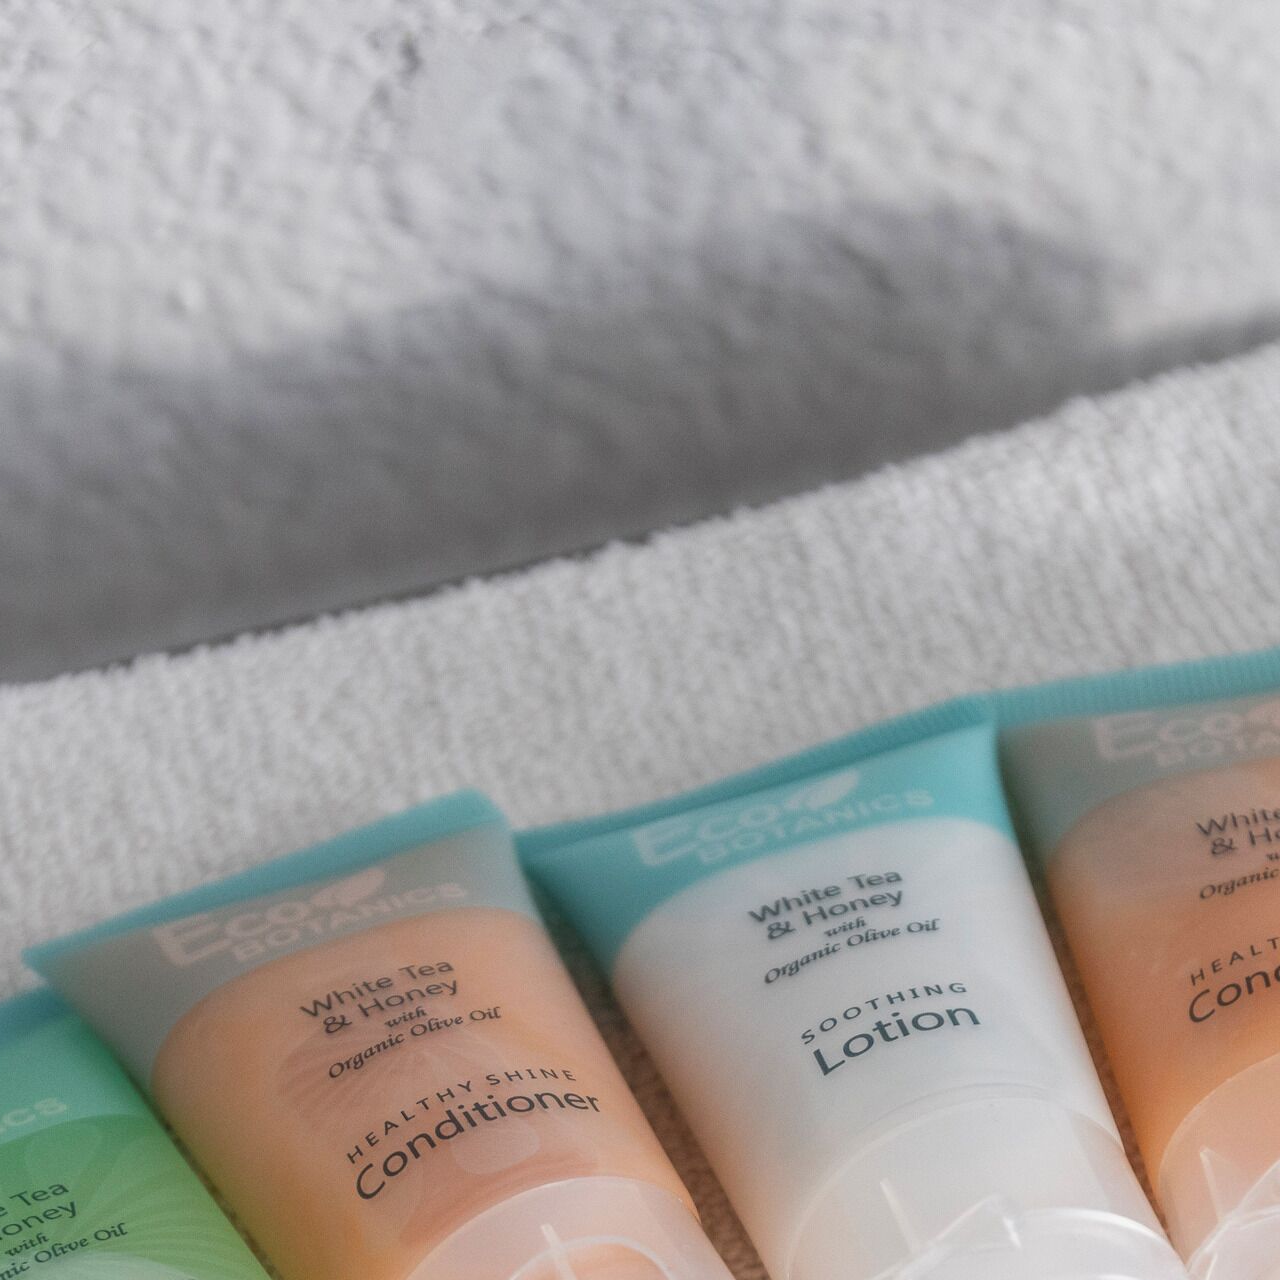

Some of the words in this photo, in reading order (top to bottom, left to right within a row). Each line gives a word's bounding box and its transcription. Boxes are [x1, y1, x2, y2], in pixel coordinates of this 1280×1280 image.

[1210, 837, 1236, 857] &
[747, 884, 842, 924] White
[847, 871, 903, 890] Tea
[1199, 866, 1280, 900] Organic
[767, 920, 797, 941] &
[802, 889, 903, 926] Honey
[824, 916, 867, 938] with
[764, 942, 842, 985] Organic
[846, 927, 901, 947] Olive
[906, 918, 940, 933] Oil
[299, 976, 394, 1018] White
[398, 961, 455, 980] Tea
[323, 1014, 353, 1034] &
[357, 979, 458, 1018] Honey
[801, 982, 967, 1045] SOOTHING
[328, 1032, 406, 1079] Organic
[410, 1015, 464, 1038] Olive
[469, 1006, 503, 1022] Oil
[384, 1005, 427, 1029] with
[813, 1007, 981, 1076] Lotion
[346, 1080, 473, 1164] HEALTHY
[485, 1068, 577, 1086] SHINE
[356, 1091, 601, 1200] Conditioner
[9, 1183, 70, 1207] Tea
[4, 1232, 50, 1257] with
[34, 1238, 89, 1264] Olive
[93, 1222, 129, 1242] Oil
